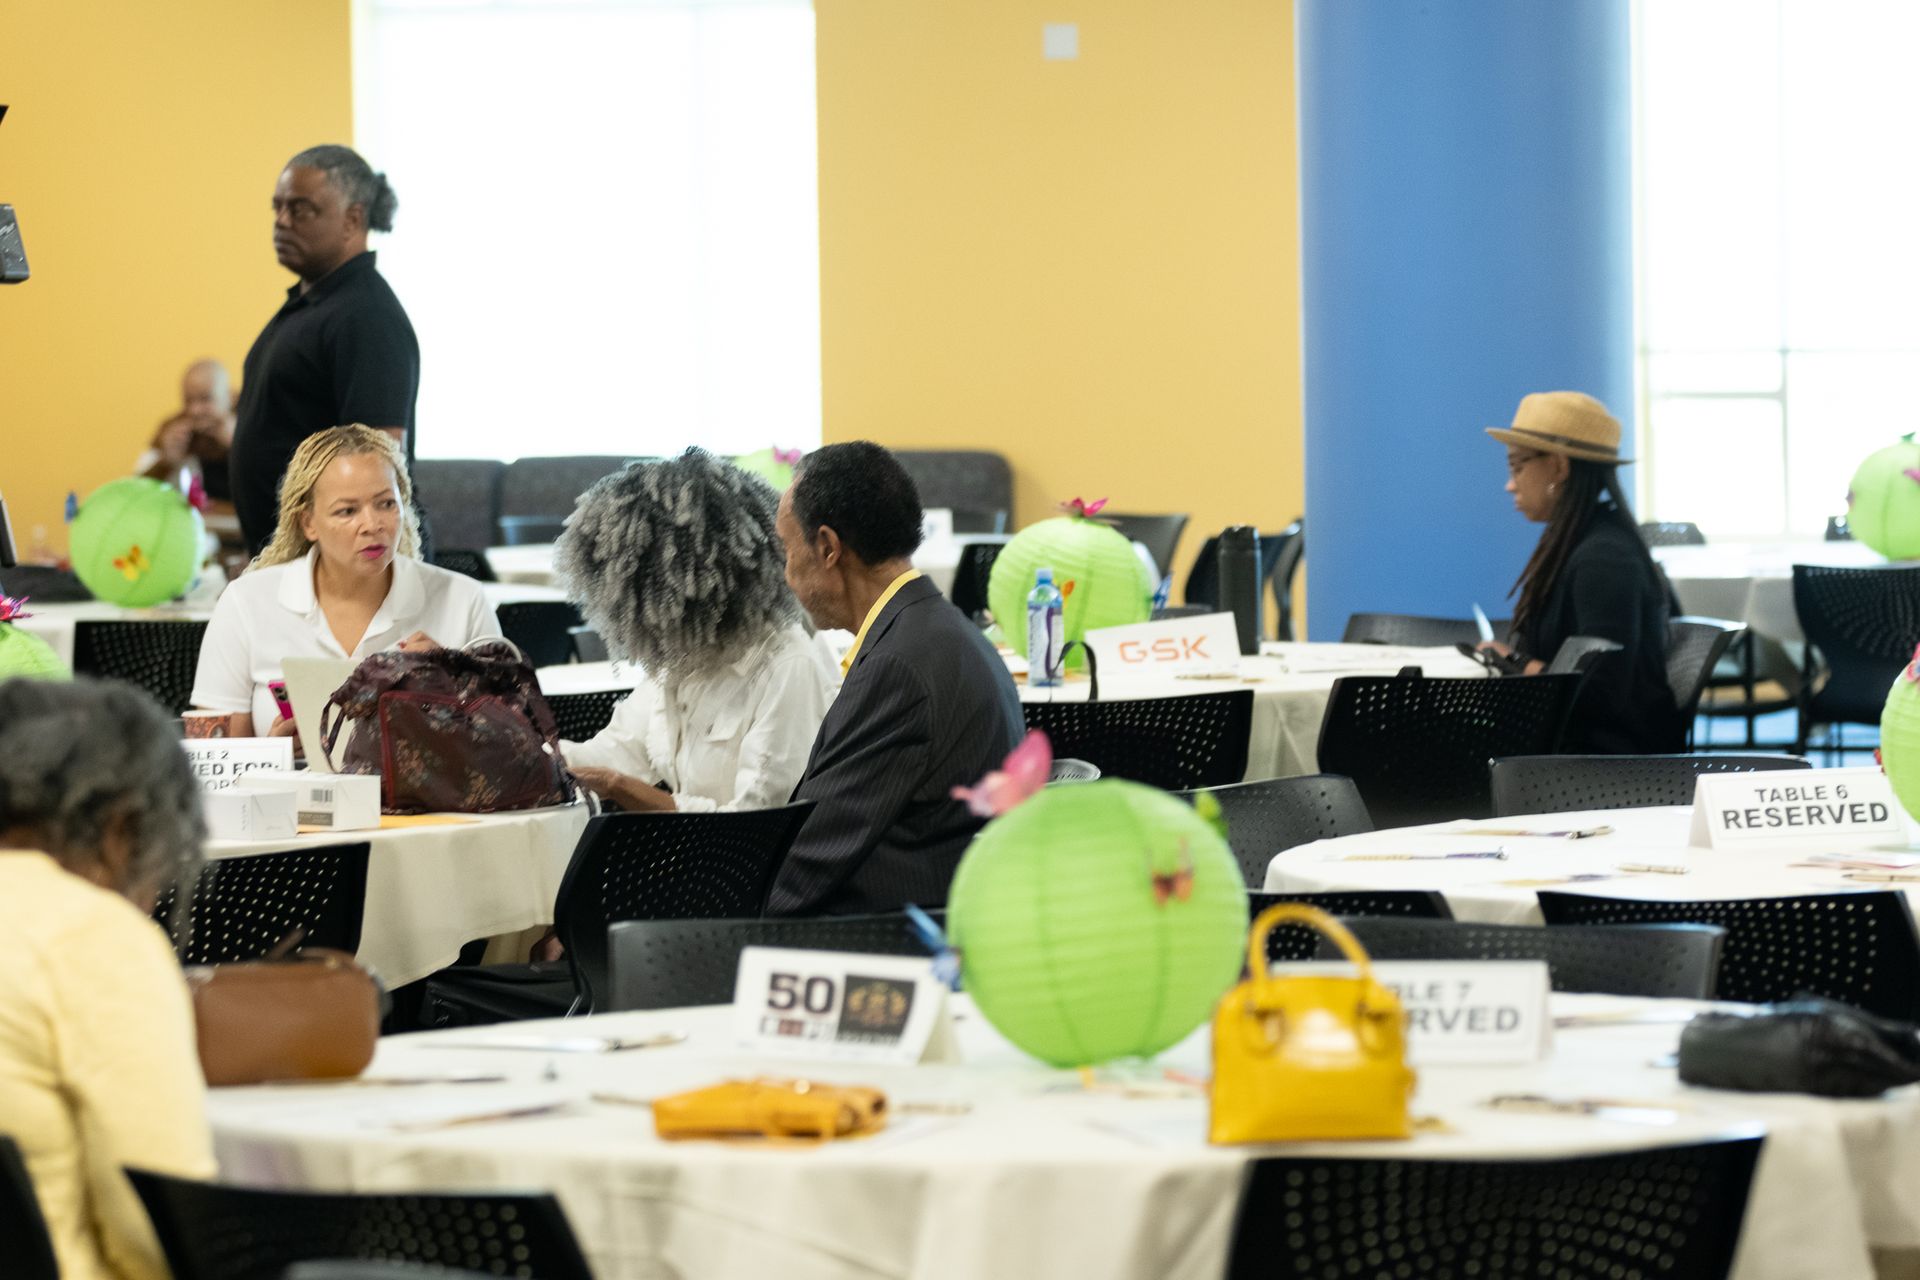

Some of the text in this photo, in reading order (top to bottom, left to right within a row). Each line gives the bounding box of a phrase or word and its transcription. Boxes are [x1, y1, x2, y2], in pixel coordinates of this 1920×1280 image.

[1119, 635, 1211, 664] GSK
[190, 750, 230, 761] BLE 2
[1754, 784, 1849, 803] TABLE 6
[1722, 802, 1889, 830] RESERVED
[767, 973, 835, 1014] 50
[1458, 981, 1475, 1002] 7
[1407, 1006, 1521, 1034] RVED
